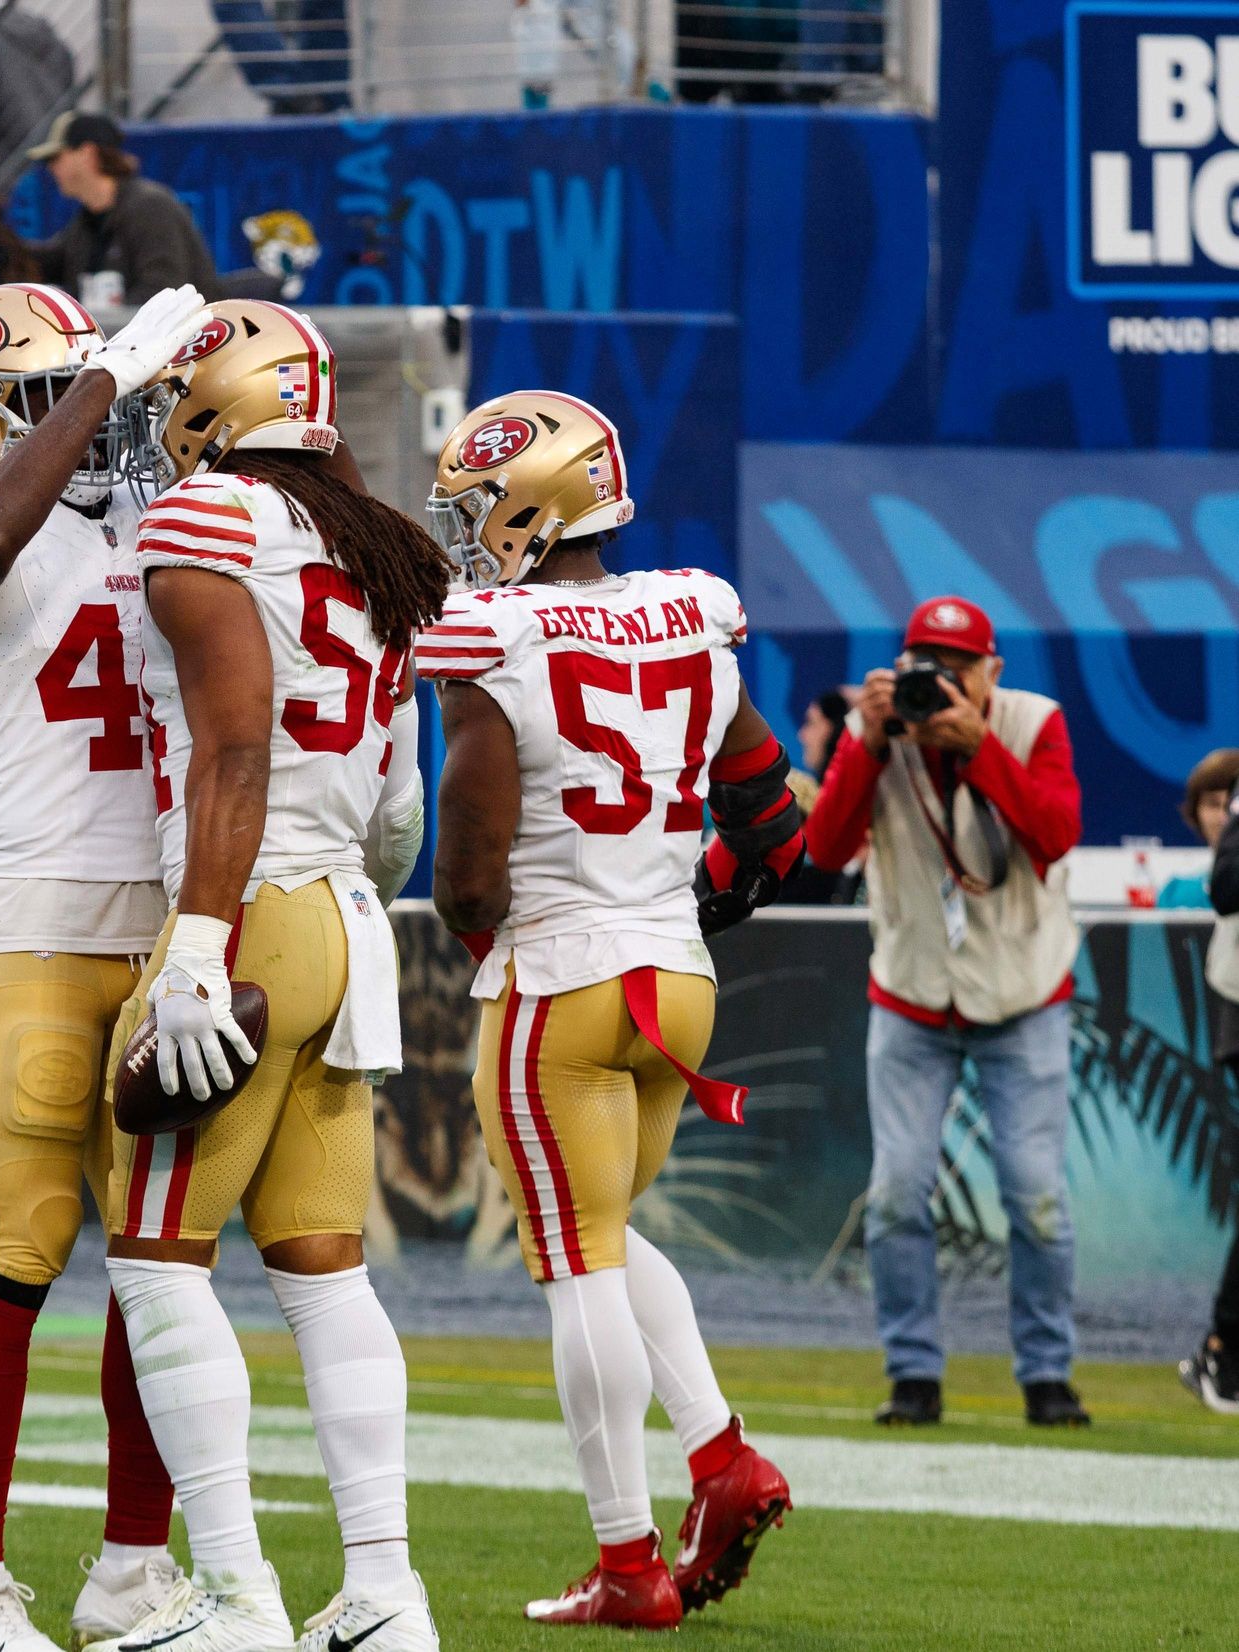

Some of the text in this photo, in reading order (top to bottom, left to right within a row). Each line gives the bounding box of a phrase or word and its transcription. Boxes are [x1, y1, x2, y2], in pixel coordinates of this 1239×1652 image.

[287, 405, 301, 417] 64
[473, 422, 522, 463] SF
[533, 596, 705, 645] GREENLAW
[35, 603, 144, 772] 4
[546, 649, 713, 834] 57
